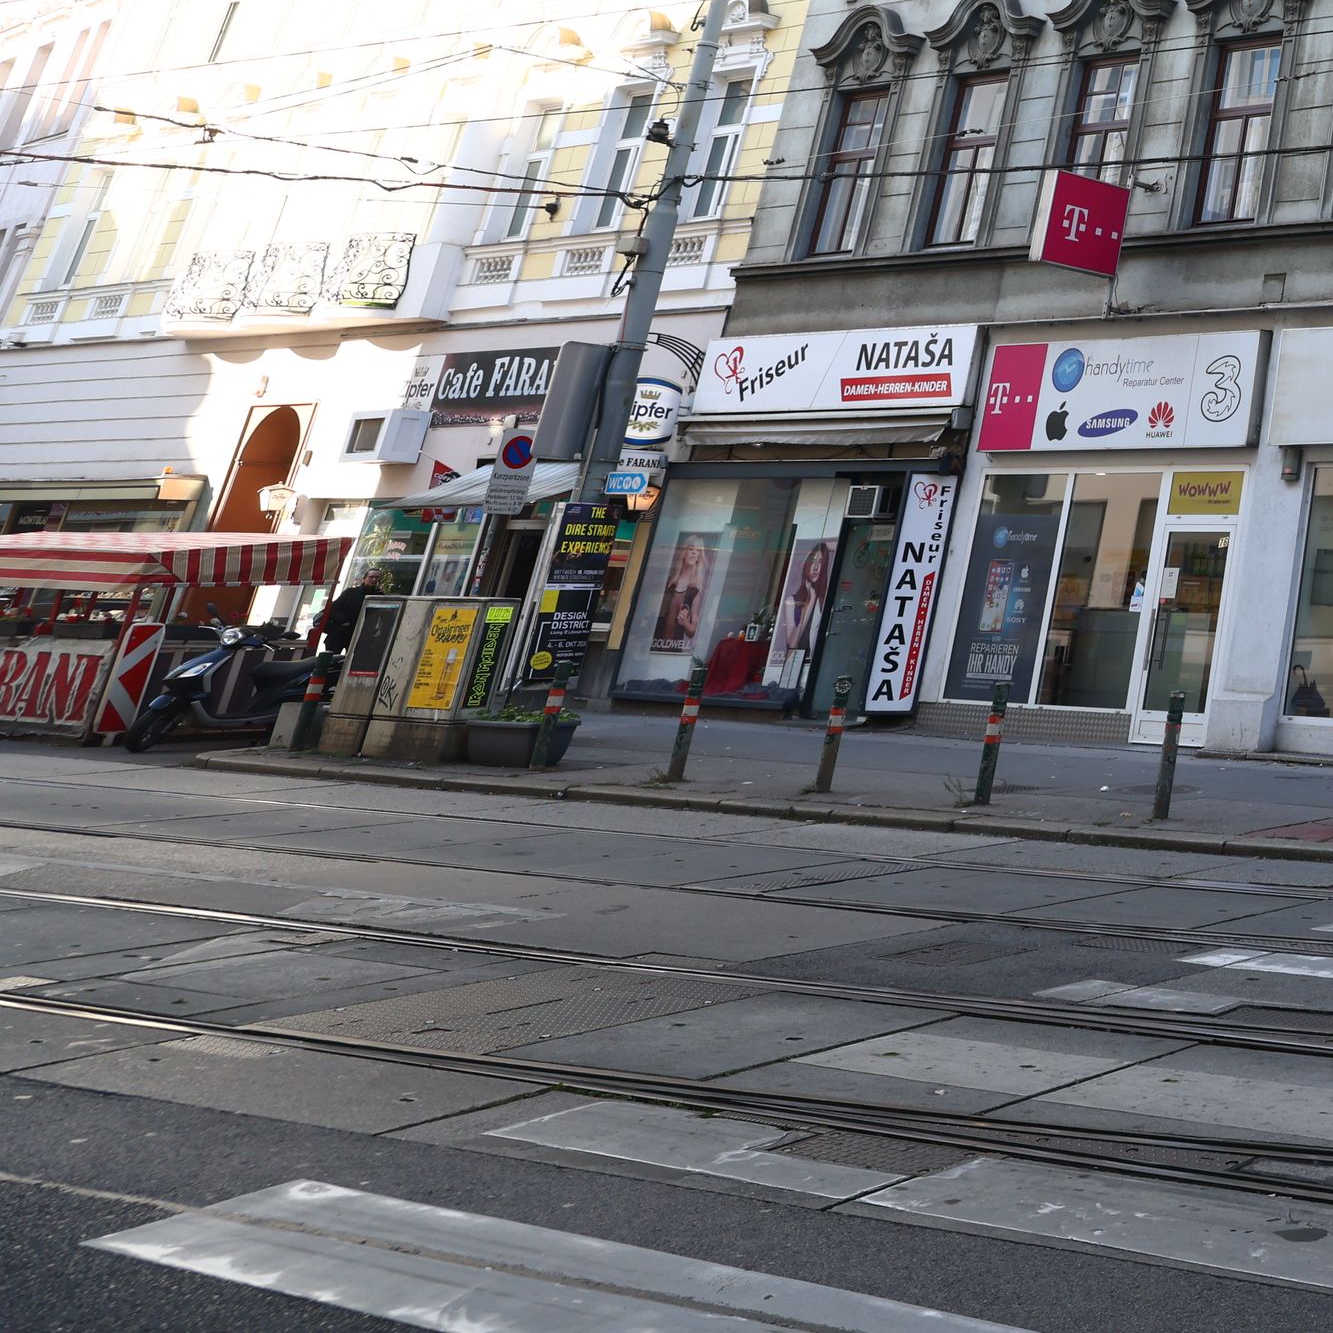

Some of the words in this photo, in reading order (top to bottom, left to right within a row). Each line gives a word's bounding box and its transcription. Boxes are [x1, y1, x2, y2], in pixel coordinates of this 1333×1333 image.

[855, 333, 953, 371] NATAŠA
[738, 343, 809, 402] Friseur
[1085, 354, 1154, 382] handytime
[437, 361, 482, 400] Cafe
[485, 356, 556, 397] FARA
[1123, 377, 1158, 388] Reparatur
[1159, 376, 1184, 386] Center
[843, 380, 948, 397] DAMEN-HERREN-KINDER
[1200, 355, 1241, 422] 3
[631, 401, 673, 421] ipfer
[1086, 416, 1131, 429] SAMSUNG
[1146, 431, 1173, 439] HUAWEI
[609, 478, 623, 490] WC
[591, 506, 608, 519] THE
[565, 523, 588, 536] DIRE
[587, 524, 616, 537] STRAITS
[928, 485, 952, 564] Friseur
[560, 541, 613, 555] EXPERIENCE
[920, 580, 931, 608] DAMEN
[553, 612, 588, 621] DESIGN
[871, 541, 926, 701] NATAŠA
[431, 623, 471, 636] Ottakringer
[551, 620, 590, 630] DISTRICT
[651, 637, 693, 649] GOLDWELL
[971, 642, 1020, 655] REPARIEREN
[967, 654, 984, 673] IHR
[984, 655, 1018, 675] HANDY
[903, 659, 915, 694] KINDER
